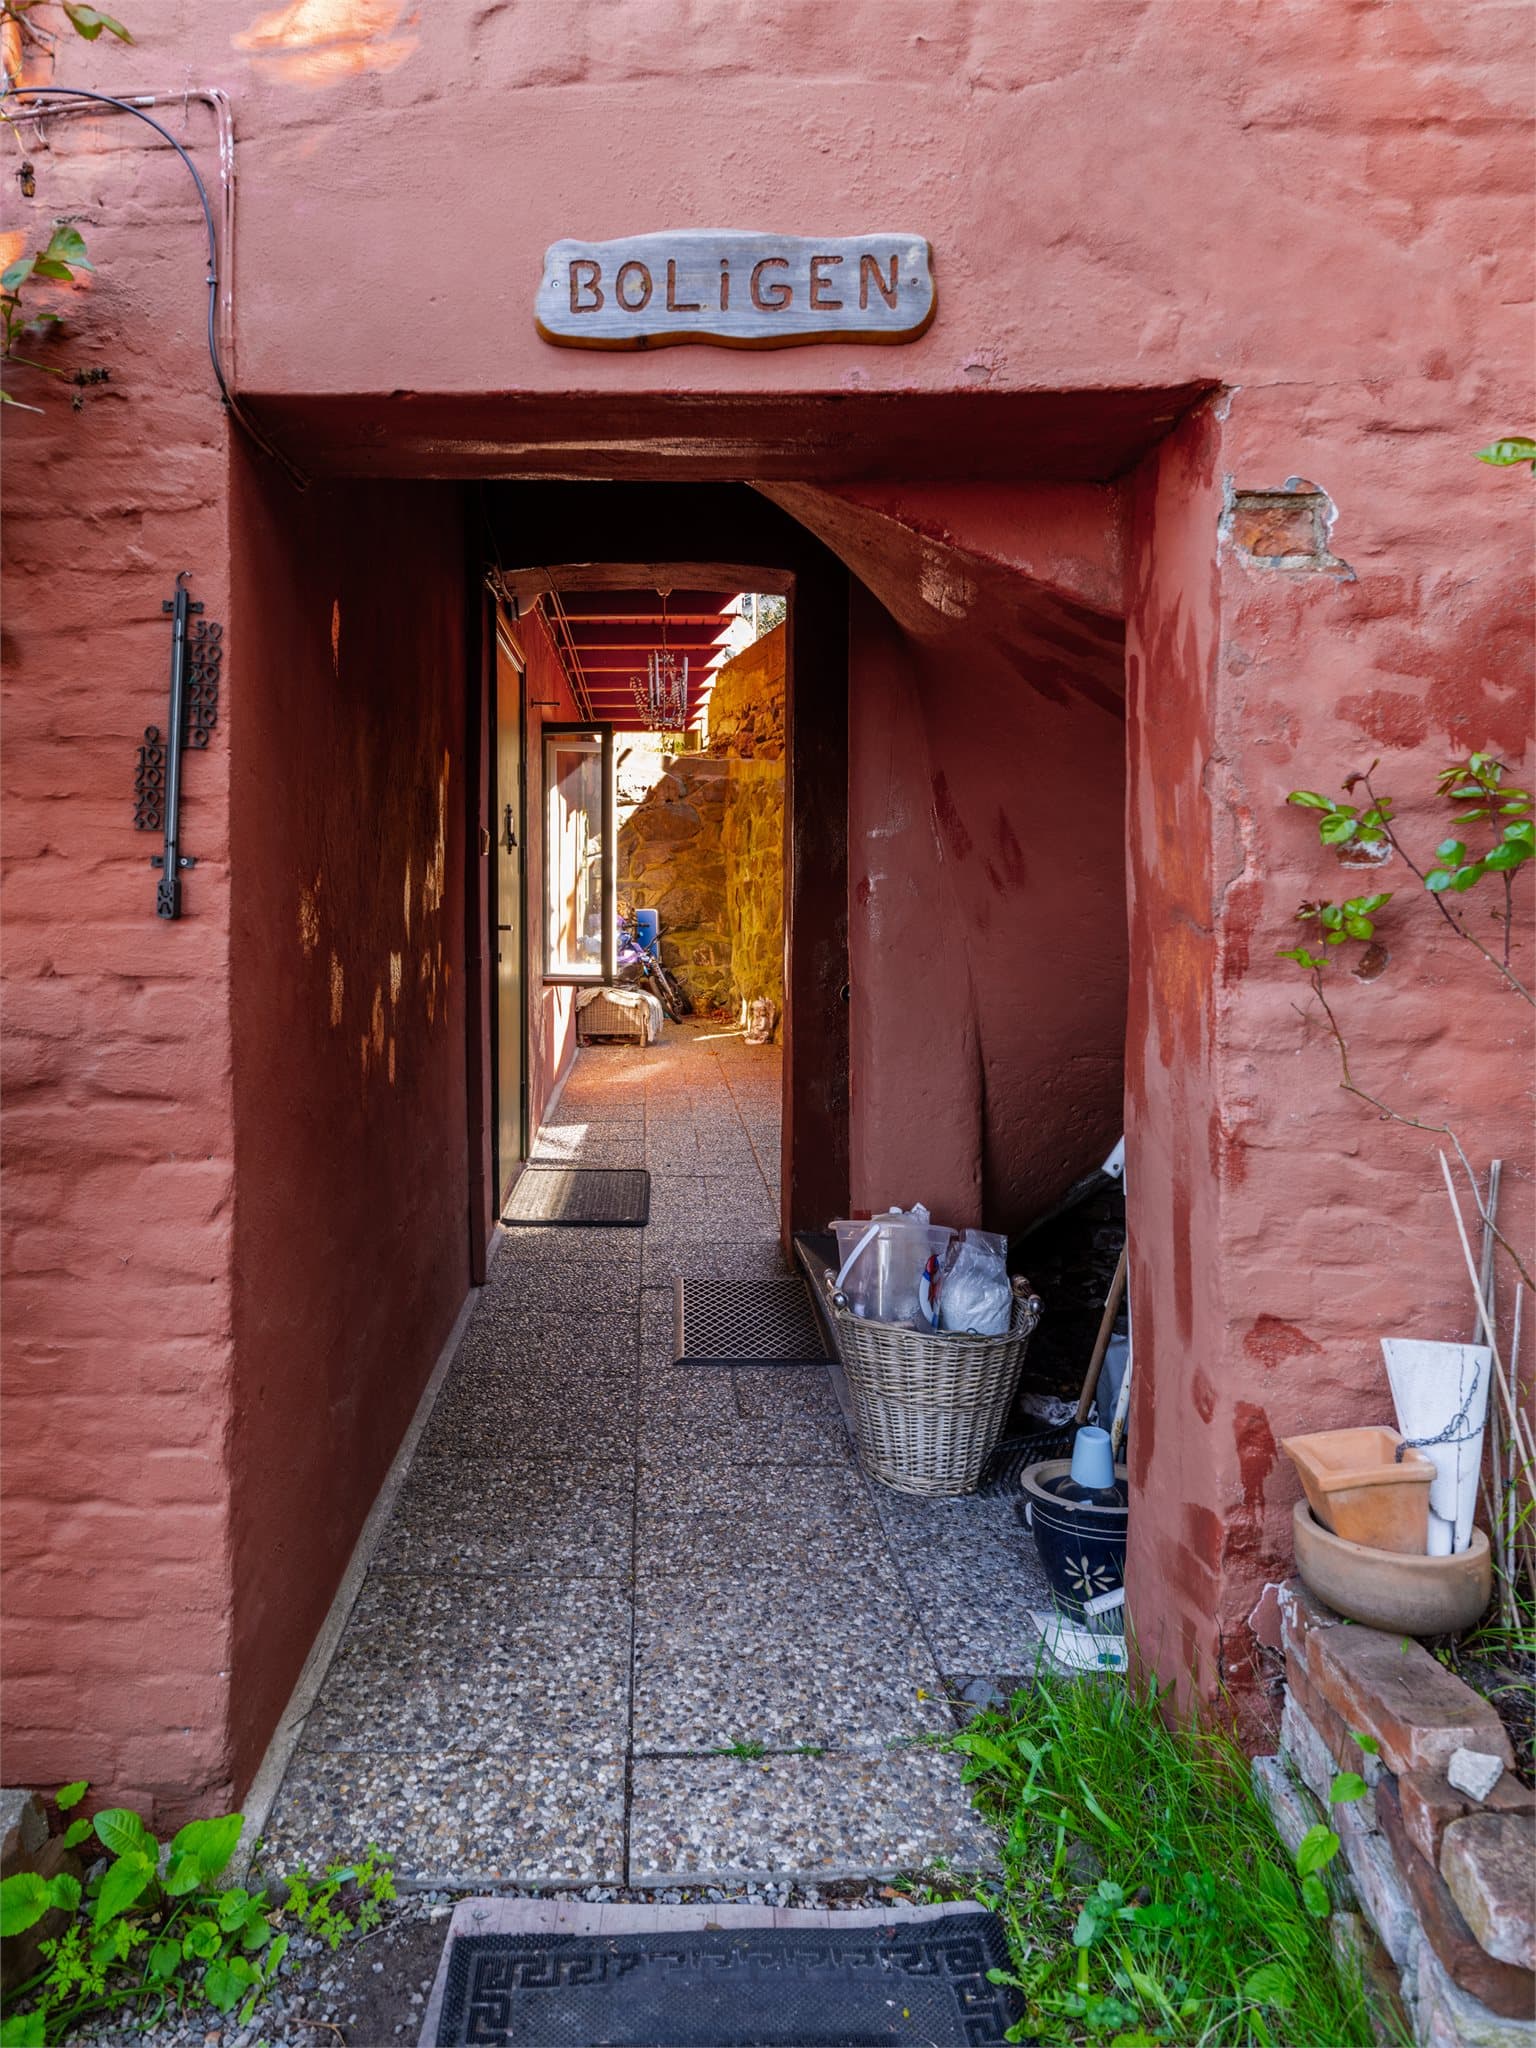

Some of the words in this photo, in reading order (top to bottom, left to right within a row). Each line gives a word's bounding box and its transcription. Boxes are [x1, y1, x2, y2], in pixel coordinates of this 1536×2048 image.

[195, 620, 222, 639] 50
[191, 684, 219, 704] 20
[192, 706, 217, 726] 10
[136, 746, 162, 766] 10
